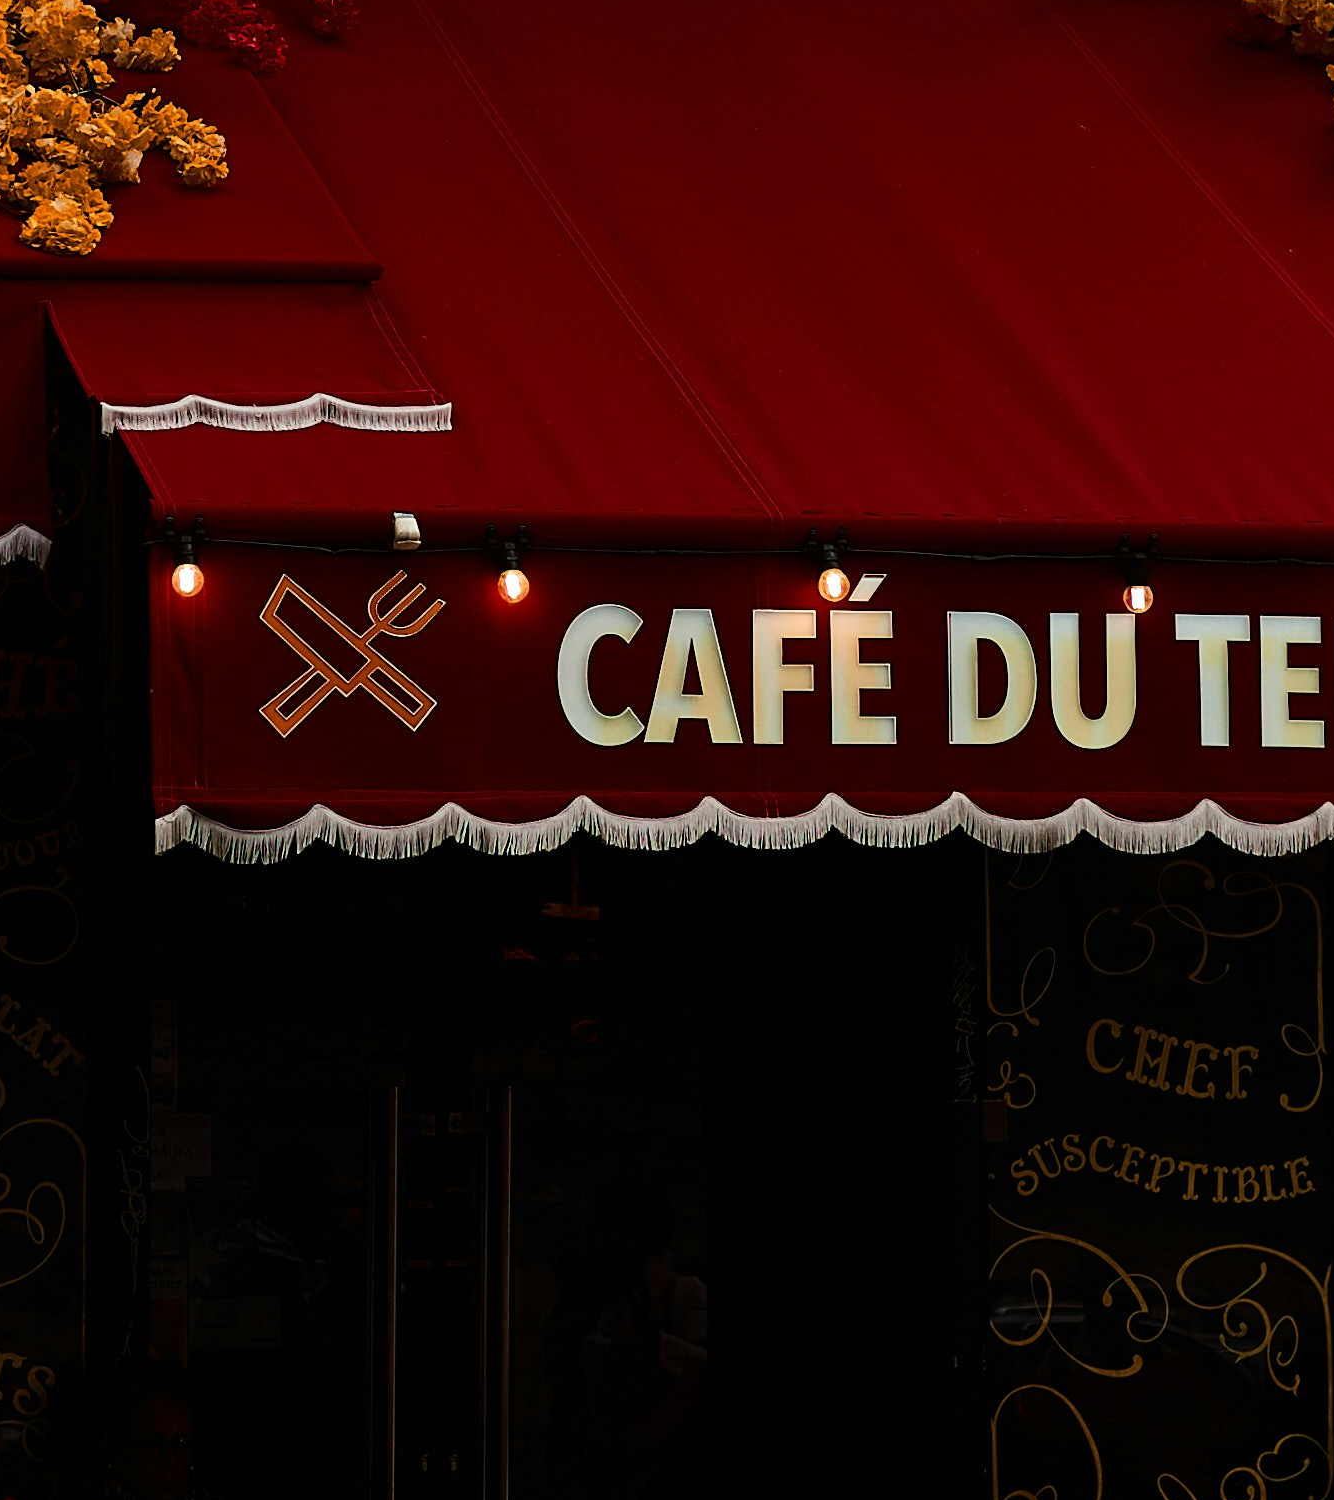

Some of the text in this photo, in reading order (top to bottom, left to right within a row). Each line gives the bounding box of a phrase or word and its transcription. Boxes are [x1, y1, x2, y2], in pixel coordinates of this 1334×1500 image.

[558, 572, 897, 747] CAFÉ
[947, 611, 1137, 750] DU
[1085, 1018, 1262, 1102] CHEF
[1010, 1133, 1319, 1205] SUSCEPTIBLE
